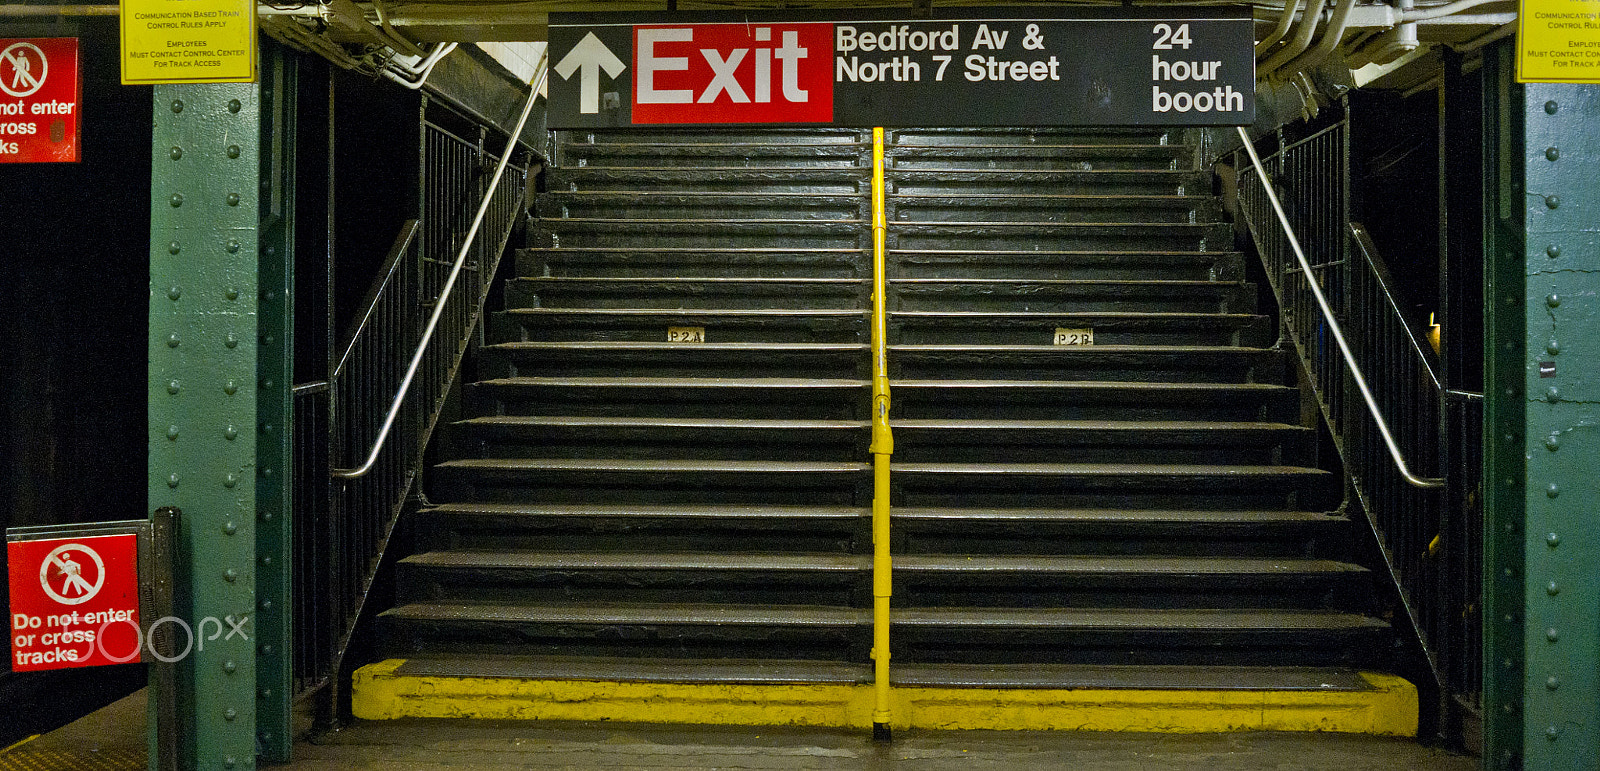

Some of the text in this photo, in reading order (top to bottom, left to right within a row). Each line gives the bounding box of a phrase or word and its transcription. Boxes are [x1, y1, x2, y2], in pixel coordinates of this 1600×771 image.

[836, 24, 1045, 52] Bedford Av &
[1152, 23, 1193, 50] 24
[636, 27, 808, 104] Exit
[836, 54, 1060, 82] North 7 Street
[1152, 55, 1221, 81] hour
[31, 99, 75, 115] enter
[1152, 86, 1243, 112] booth
[13, 608, 135, 630] Do not enter
[14, 629, 96, 647] or cross
[16, 647, 79, 666] tracks
